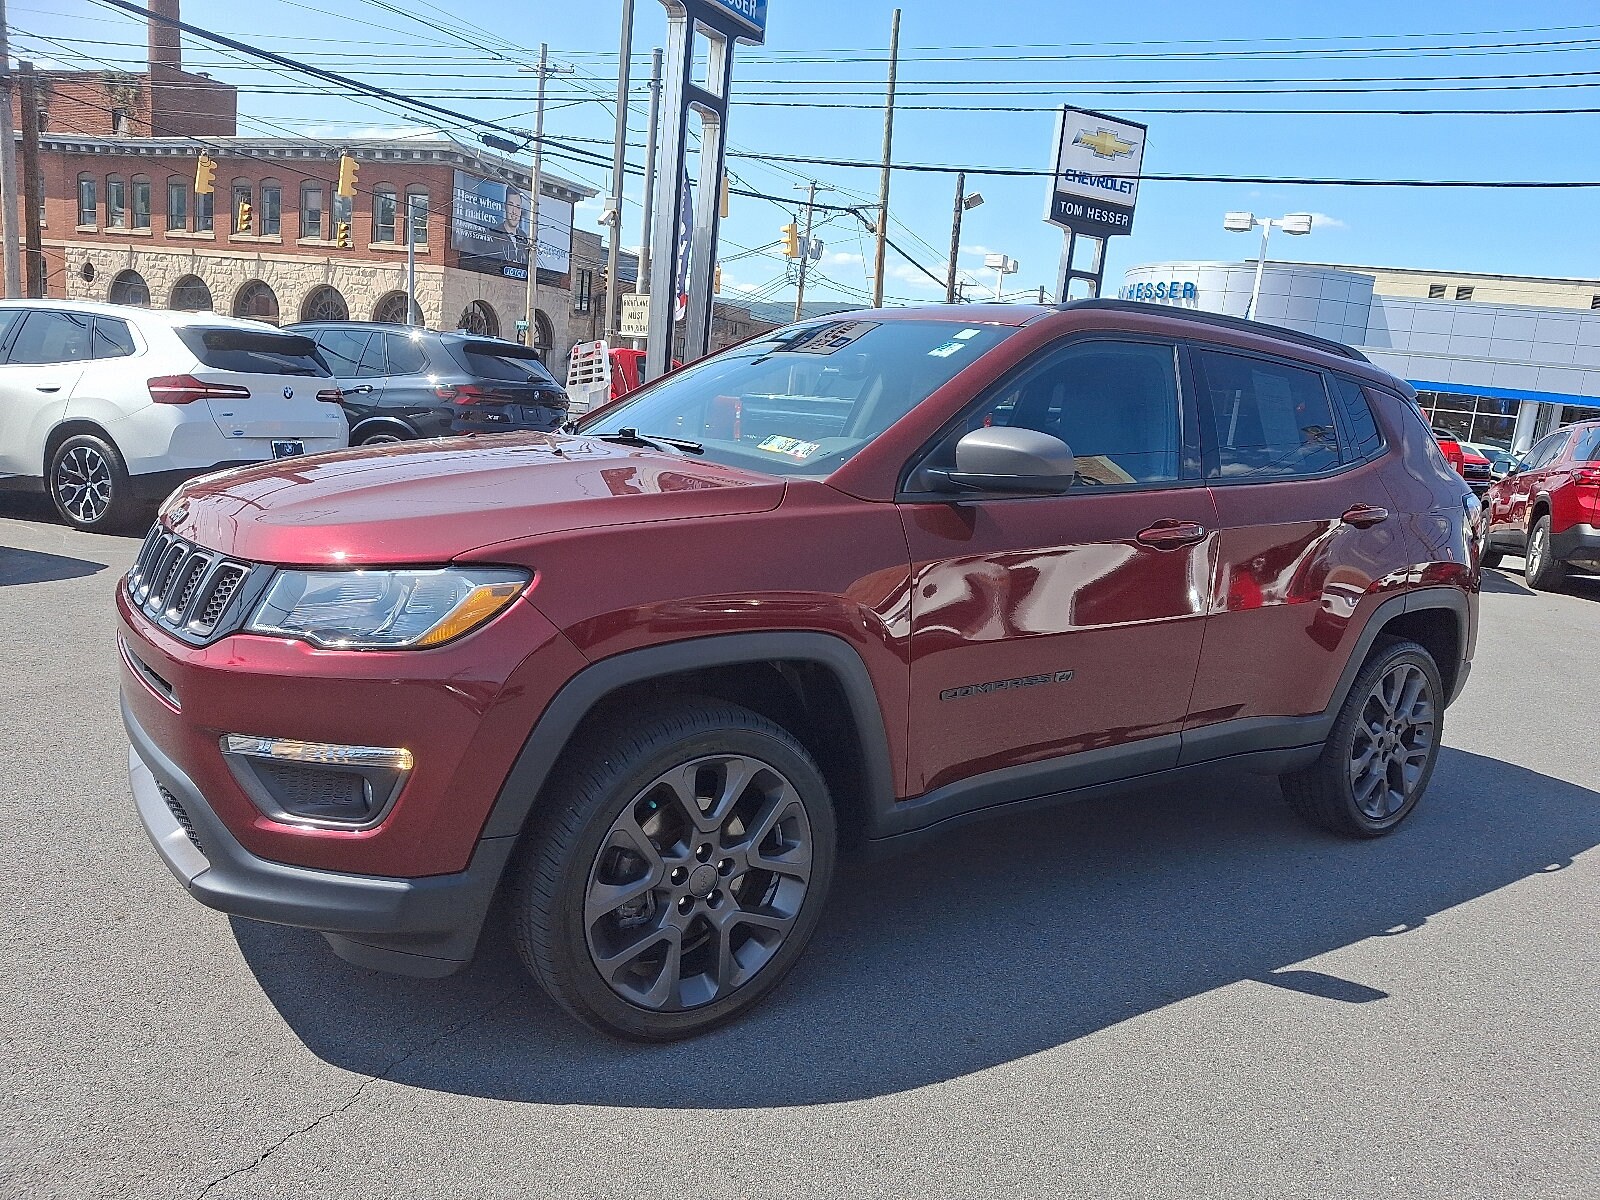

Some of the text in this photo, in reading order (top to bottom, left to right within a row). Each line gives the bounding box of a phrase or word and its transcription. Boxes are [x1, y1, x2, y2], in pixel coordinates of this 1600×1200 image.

[1065, 168, 1135, 195] CHEVROLET
[456, 202, 463, 216] it
[457, 188, 502, 211] Here when
[1060, 201, 1129, 227] TOM HESSER
[627, 311, 644, 321] MUST
[939, 673, 1054, 701] COMPASS
